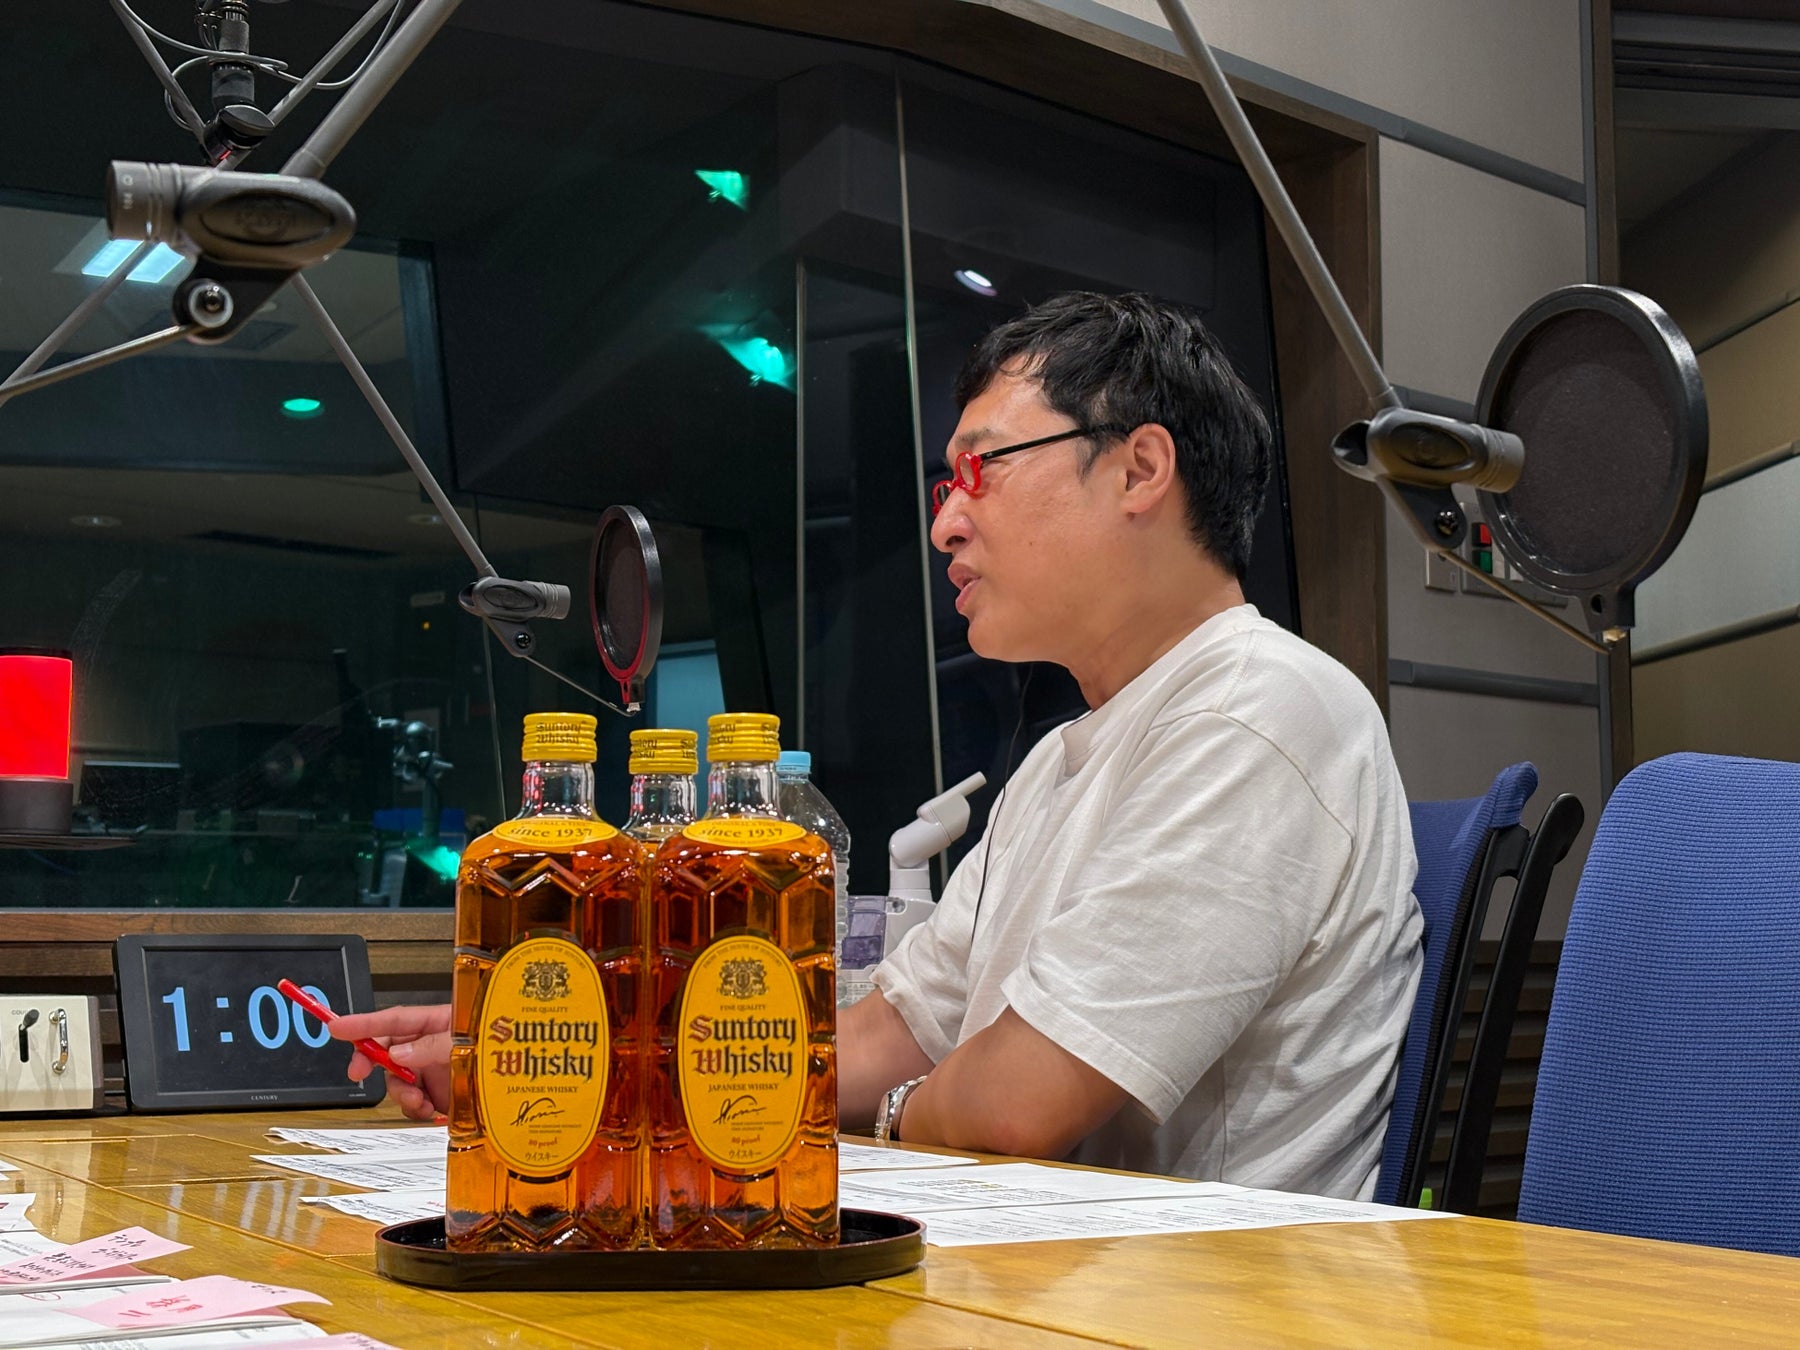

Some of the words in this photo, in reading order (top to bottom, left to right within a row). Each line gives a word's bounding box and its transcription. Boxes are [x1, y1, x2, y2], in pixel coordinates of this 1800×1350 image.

[509, 826, 550, 838] since
[556, 827, 592, 838] 1937
[700, 826, 742, 838] since
[748, 827, 783, 838] 1937
[538, 1006, 568, 1014] QUALITY
[736, 1004, 766, 1012] QUALITY
[487, 1015, 599, 1050] Suntory
[687, 1014, 797, 1047] Suntory
[490, 1046, 594, 1082] Whisky
[691, 1043, 793, 1079] Whisky
[506, 1086, 546, 1095] JAPANESE
[707, 1084, 747, 1093] JAPANESE
[747, 1083, 779, 1091] WHISKY
